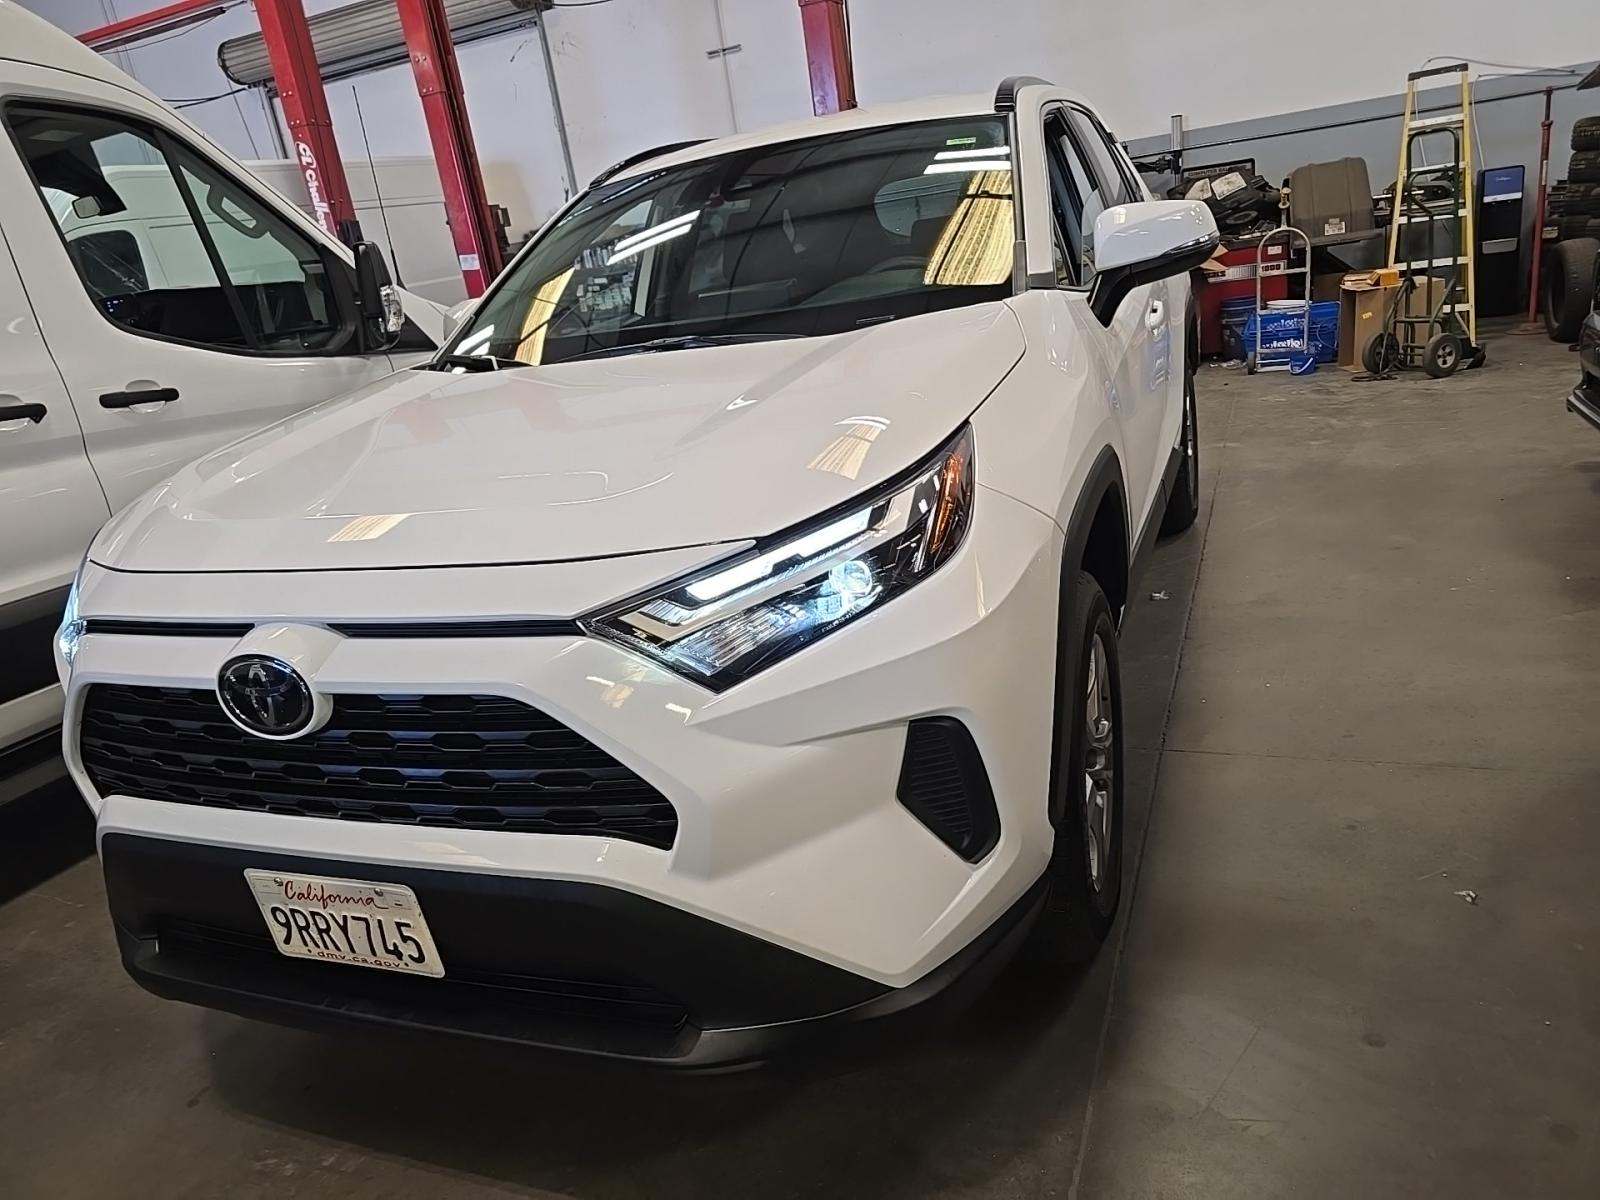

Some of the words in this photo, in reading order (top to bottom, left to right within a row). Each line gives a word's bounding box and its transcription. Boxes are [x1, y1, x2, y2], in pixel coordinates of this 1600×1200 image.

[284, 880, 389, 910] California
[270, 906, 426, 964] 9RRY745
[317, 951, 400, 968] dmv.ca.gov
